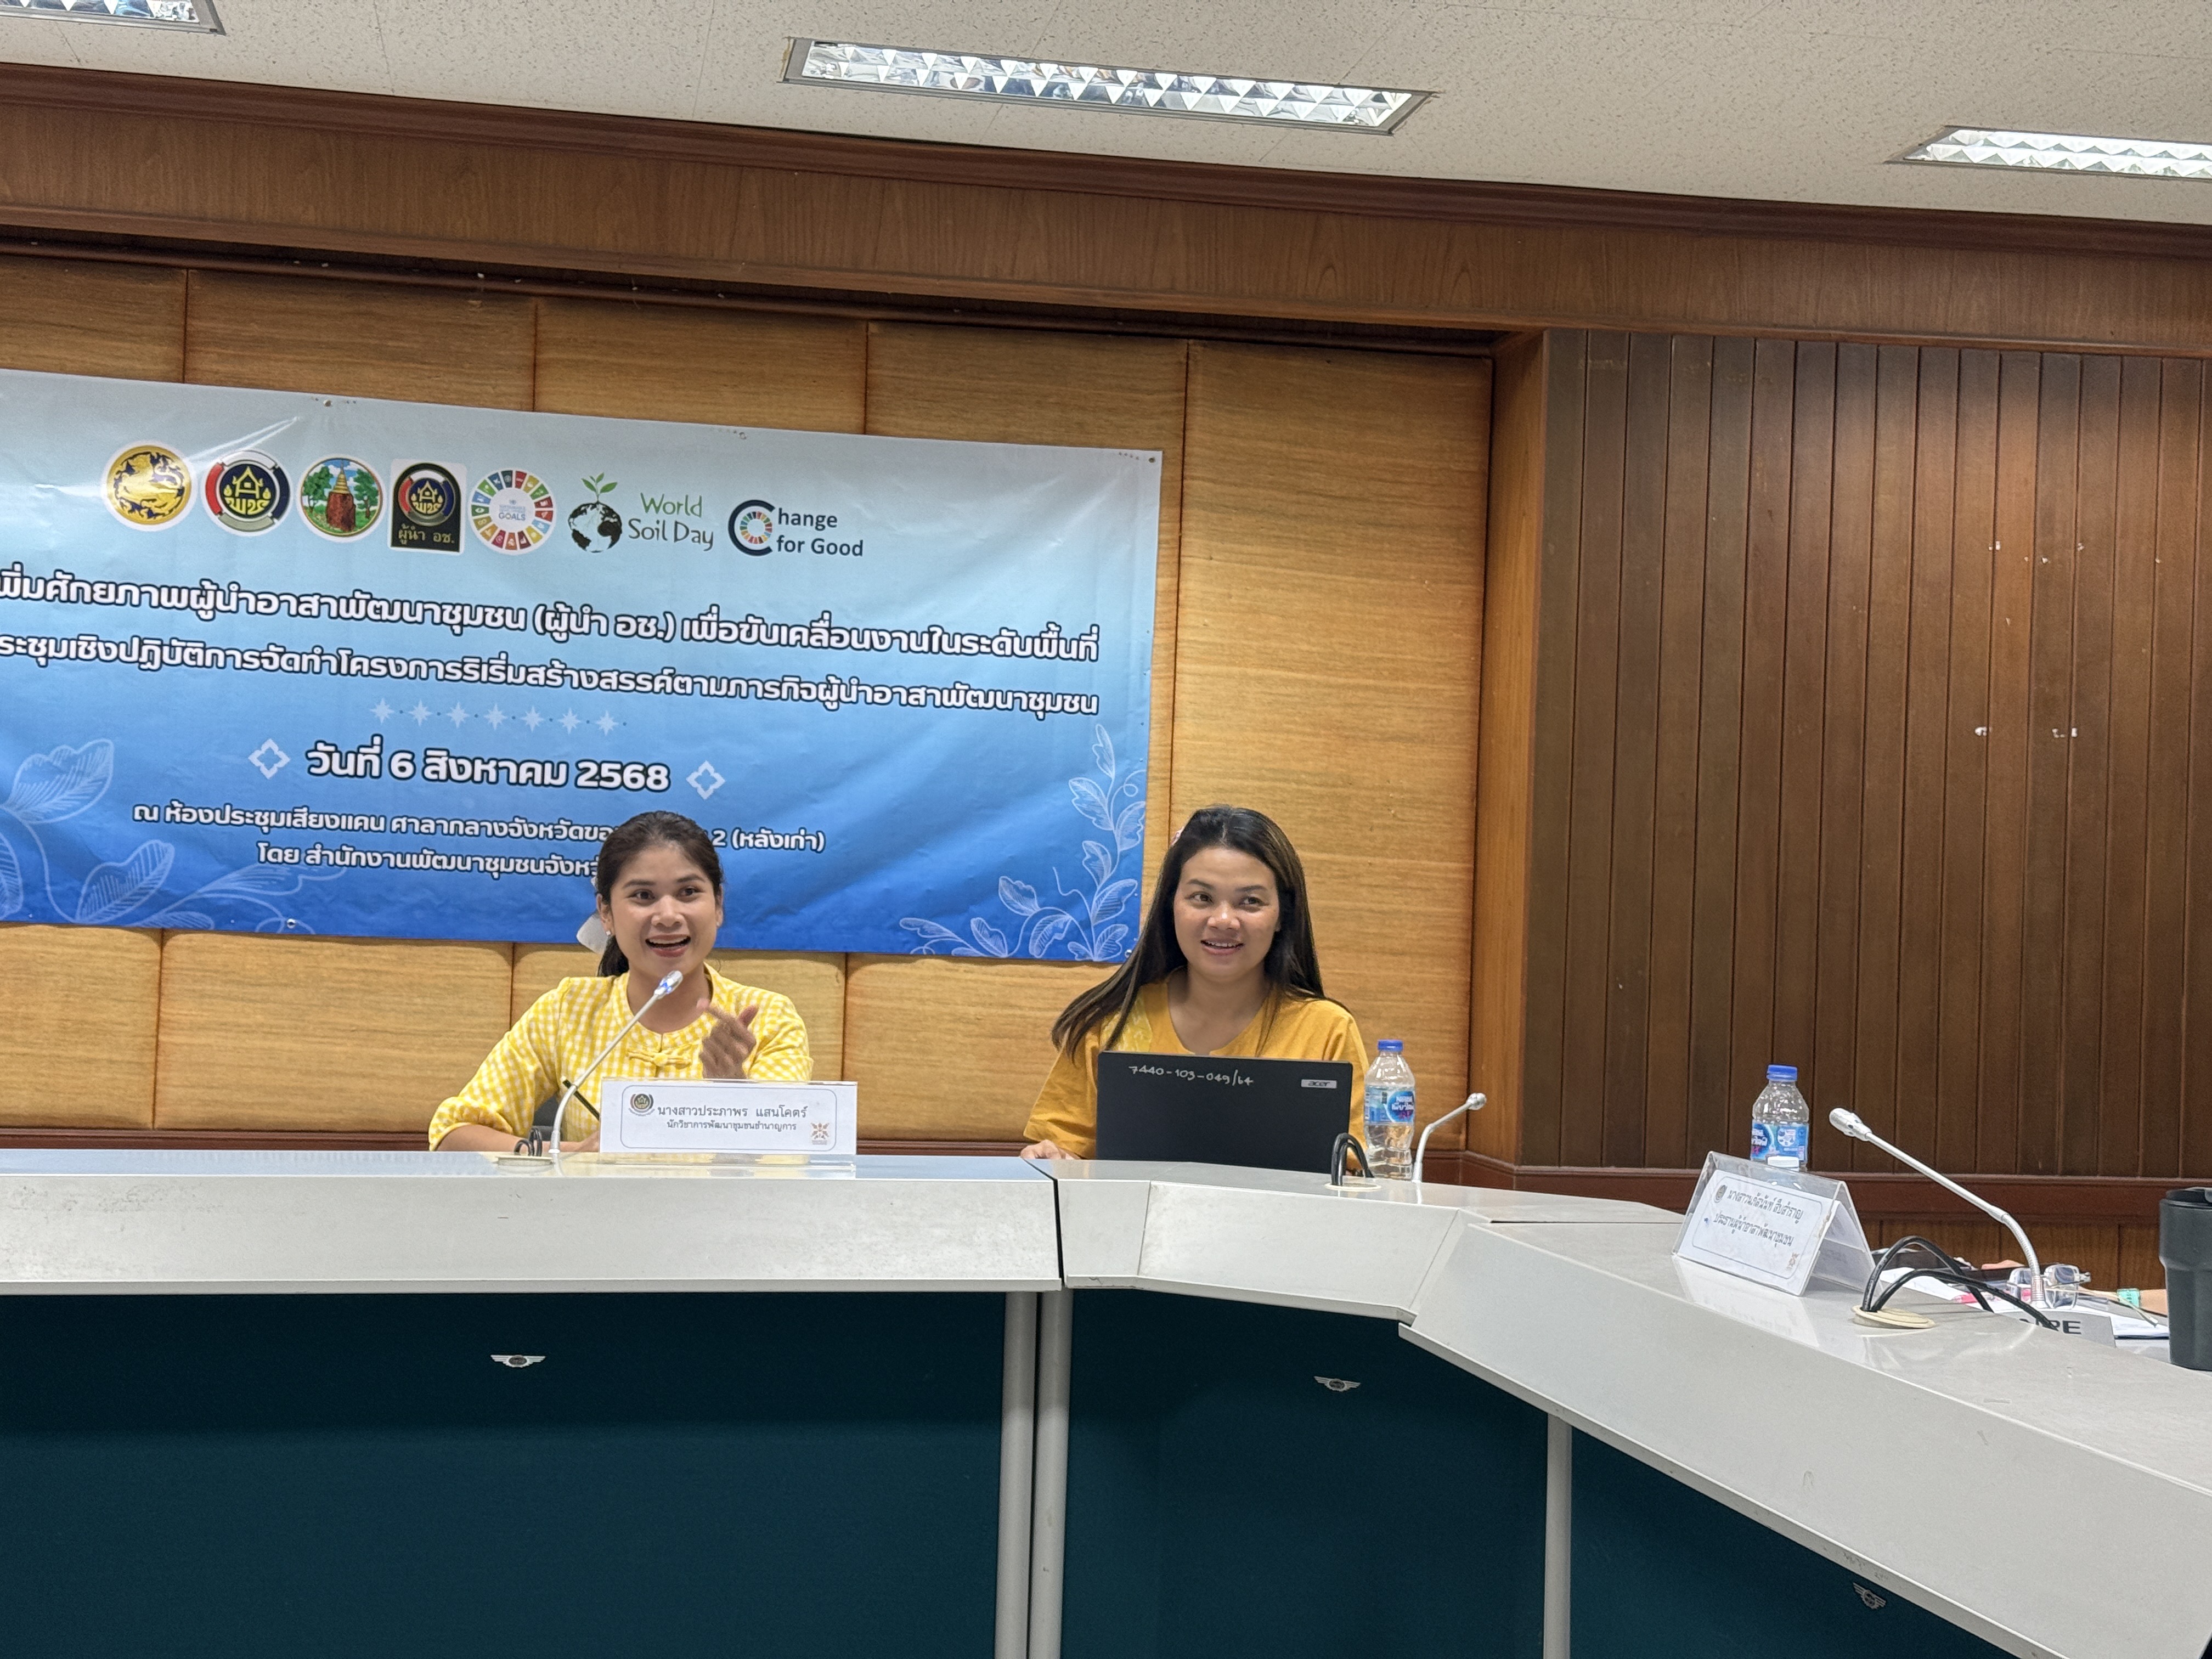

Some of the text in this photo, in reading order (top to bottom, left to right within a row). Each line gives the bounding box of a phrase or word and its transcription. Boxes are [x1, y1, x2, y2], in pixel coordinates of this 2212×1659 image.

[498, 512, 526, 521] GOALS
[640, 493, 703, 517] World
[398, 523, 455, 545] ผู้นำ อช.
[628, 518, 714, 552] Soil Day
[776, 535, 864, 557] for Good
[533, 603, 608, 642] (ผู้นำ
[613, 612, 676, 642] อช.)
[681, 605, 1099, 661] เพื่อขับเคลื่อนงานในระดับพื้นที่
[306, 733, 671, 792] วันที่ 6 สิงหาคม 2568
[133, 803, 159, 822] ณ
[164, 799, 386, 834] ห้องประชุมเสียงแคน
[390, 814, 618, 843] ศาลากลางจังหวัดขอ
[731, 827, 826, 853] (หลังเก่า)
[256, 842, 300, 866] โดย
[657, 1105, 748, 1116] นางสาวประภาพร
